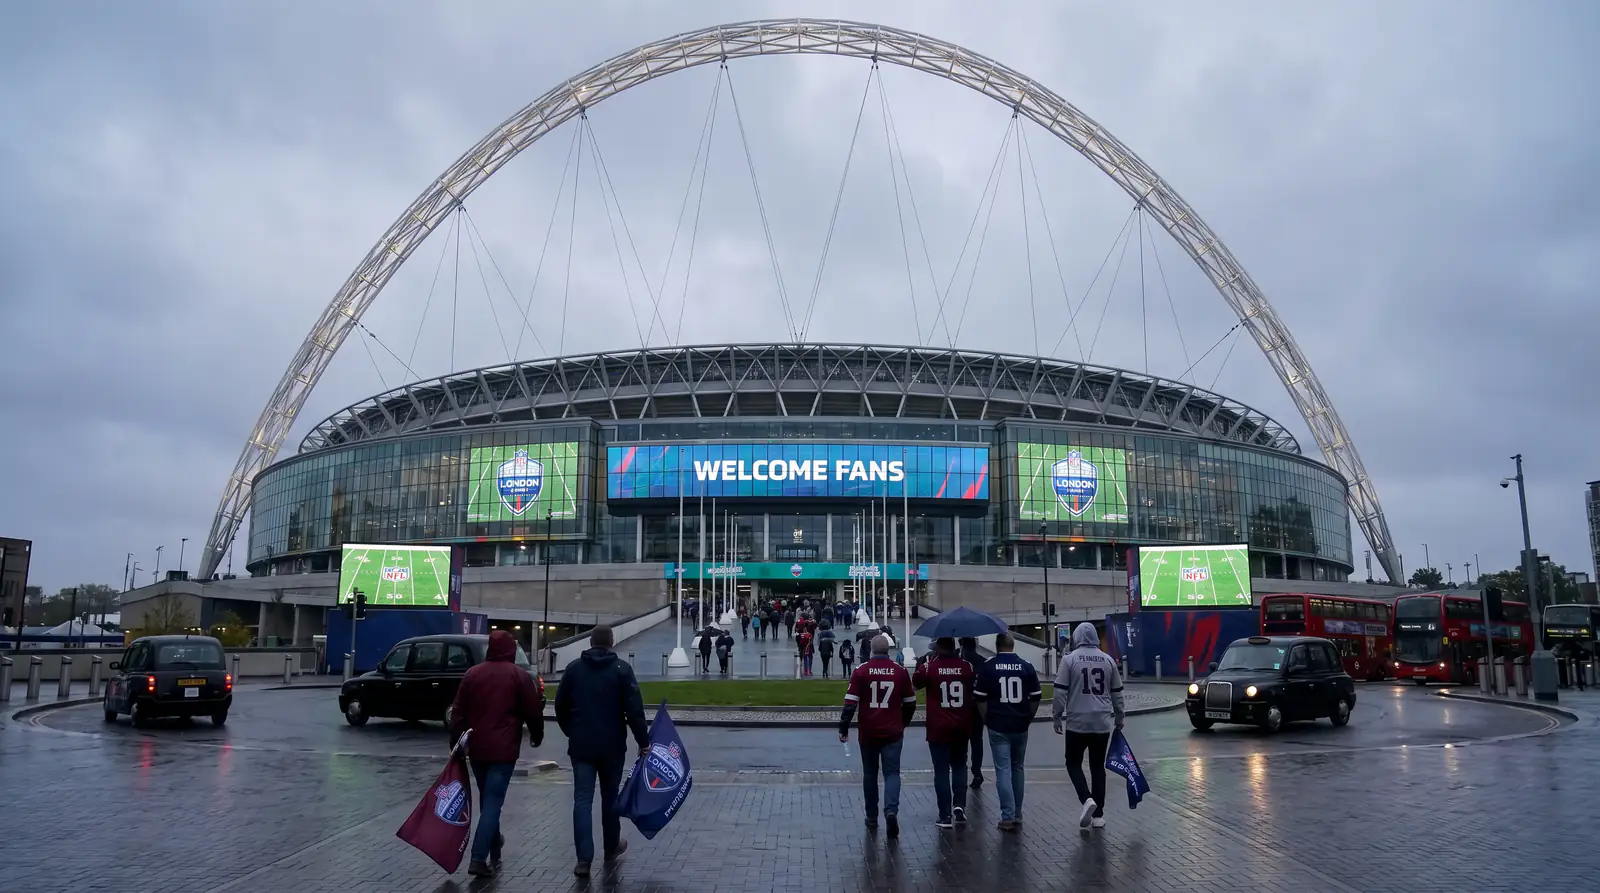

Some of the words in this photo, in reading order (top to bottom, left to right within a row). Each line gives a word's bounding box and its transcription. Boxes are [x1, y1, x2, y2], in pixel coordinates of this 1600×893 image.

[694, 459, 828, 481] WELCOME
[835, 460, 904, 482] FANS
[500, 478, 539, 489] LONDON
[1056, 479, 1095, 489] LONDON
[386, 572, 406, 580] NFL
[1186, 572, 1205, 580] NFL
[998, 676, 1023, 703] 10
[1081, 667, 1105, 695] 13
[869, 681, 895, 708] 17
[939, 681, 964, 708] 19
[647, 755, 678, 783] LONDON
